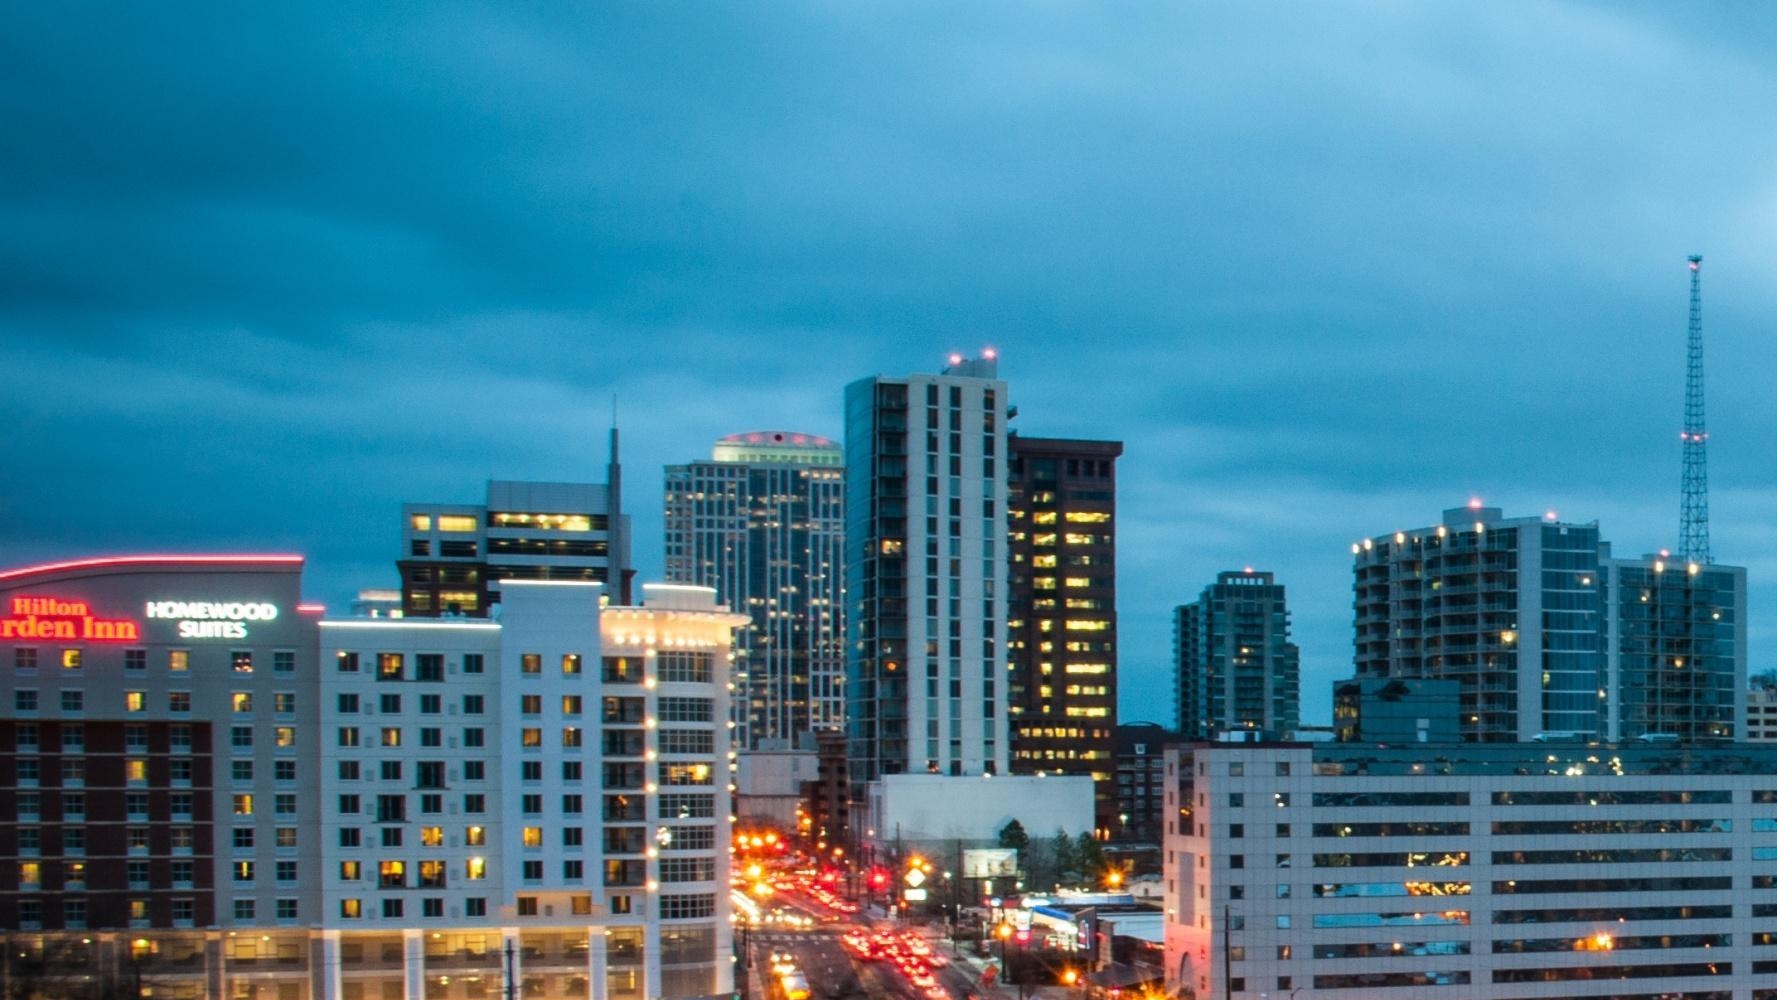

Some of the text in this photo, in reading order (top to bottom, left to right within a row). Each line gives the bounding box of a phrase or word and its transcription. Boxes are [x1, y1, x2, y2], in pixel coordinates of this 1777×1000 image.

[13, 598, 87, 616] Hilton
[146, 601, 278, 620] HOMEWOOD
[0, 615, 138, 640] rden Inn
[178, 620, 248, 639] SUITES
